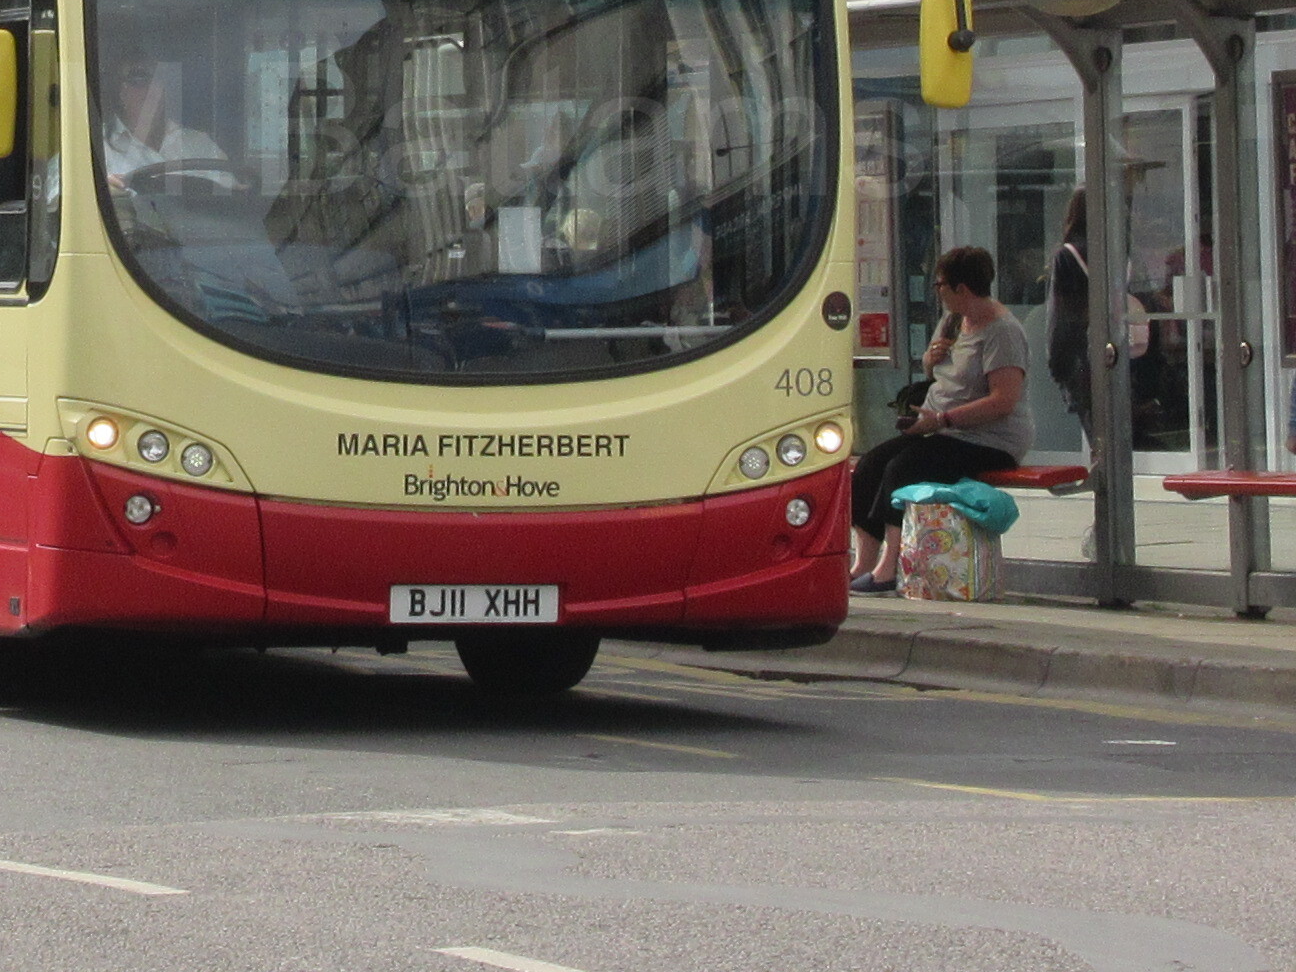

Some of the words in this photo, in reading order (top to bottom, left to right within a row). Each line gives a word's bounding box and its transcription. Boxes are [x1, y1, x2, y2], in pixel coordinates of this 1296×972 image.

[774, 368, 835, 399] 408
[336, 433, 430, 457] MARIA
[437, 433, 631, 458] FITZHERBERT
[484, 587, 541, 617] XHH
